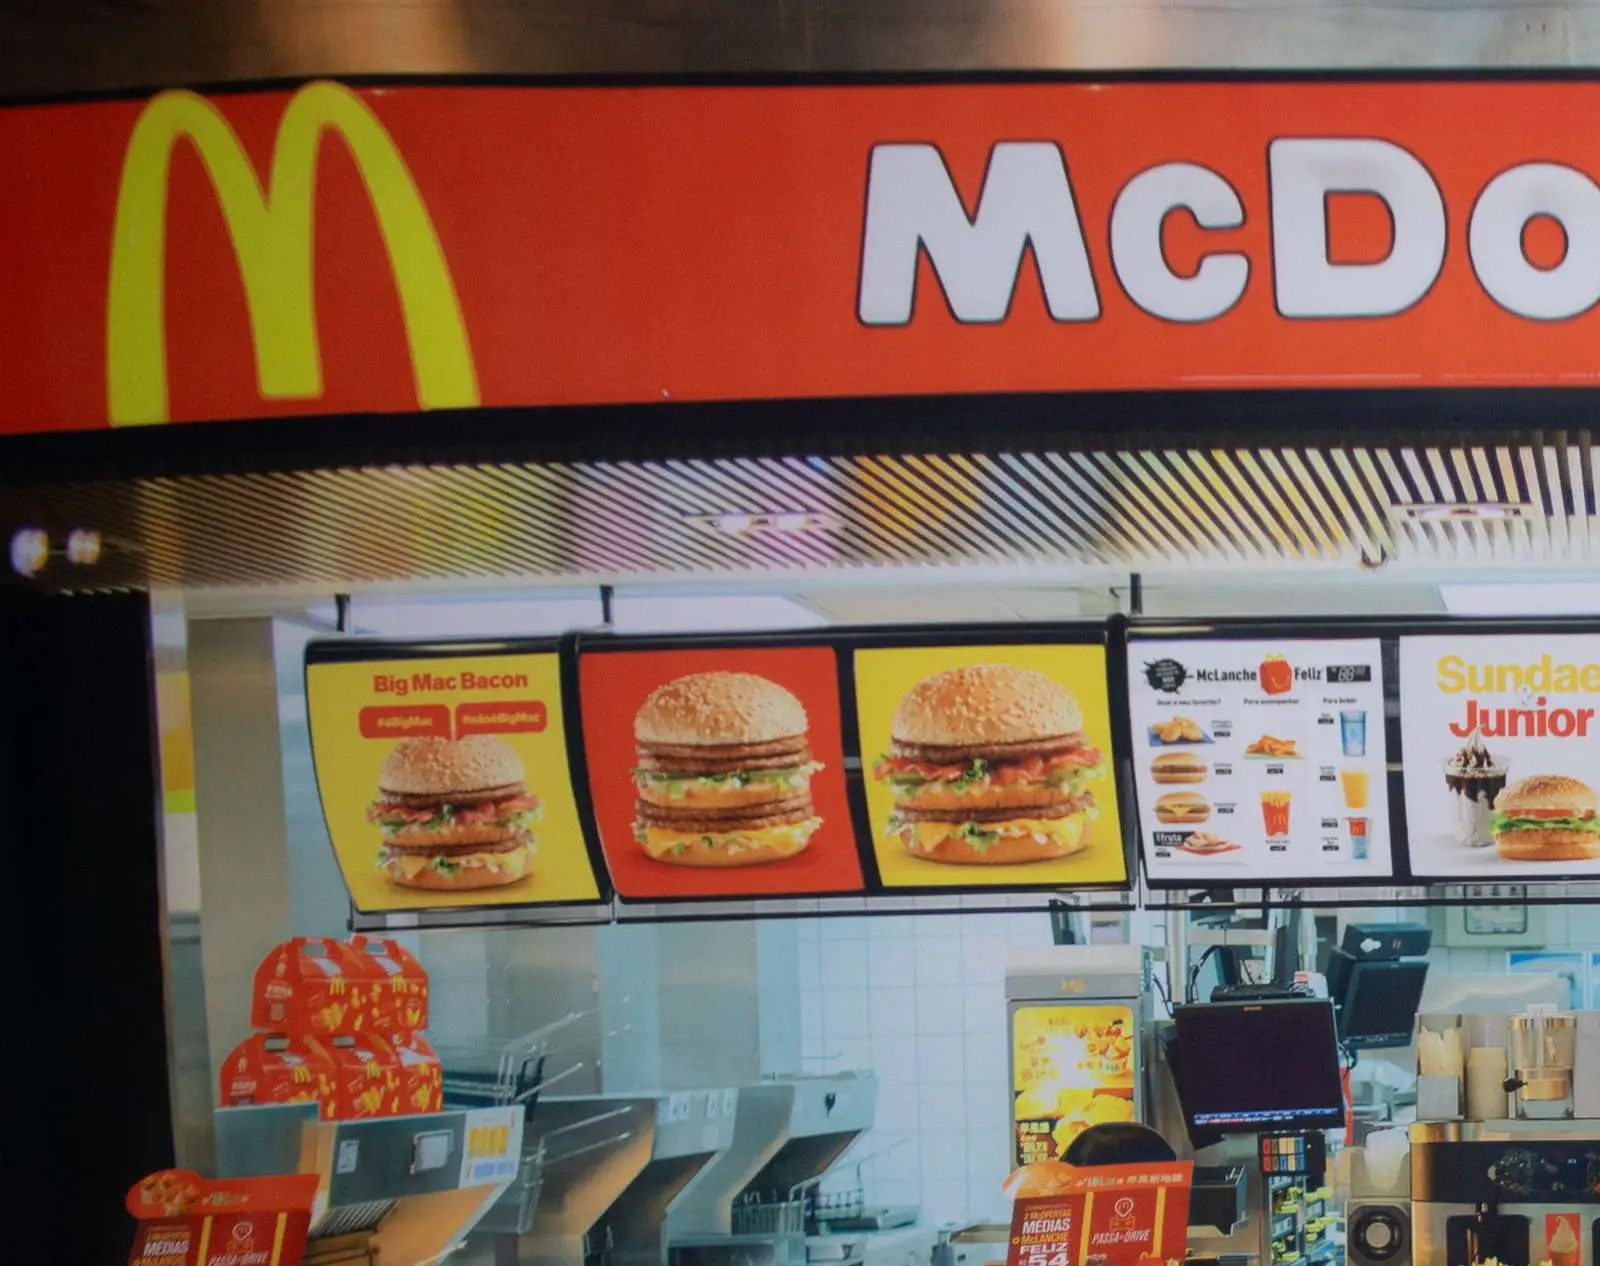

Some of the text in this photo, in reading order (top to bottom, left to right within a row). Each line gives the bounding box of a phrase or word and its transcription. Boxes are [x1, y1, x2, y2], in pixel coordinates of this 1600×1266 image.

[373, 671, 528, 695] Big Mac Bacon
[1196, 668, 1257, 681] McLanche
[1295, 667, 1322, 680] Feliz
[1448, 696, 1595, 738] Junior
[1022, 1217, 1071, 1235] MÉDIAS
[1019, 1242, 1069, 1256] FELIZ
